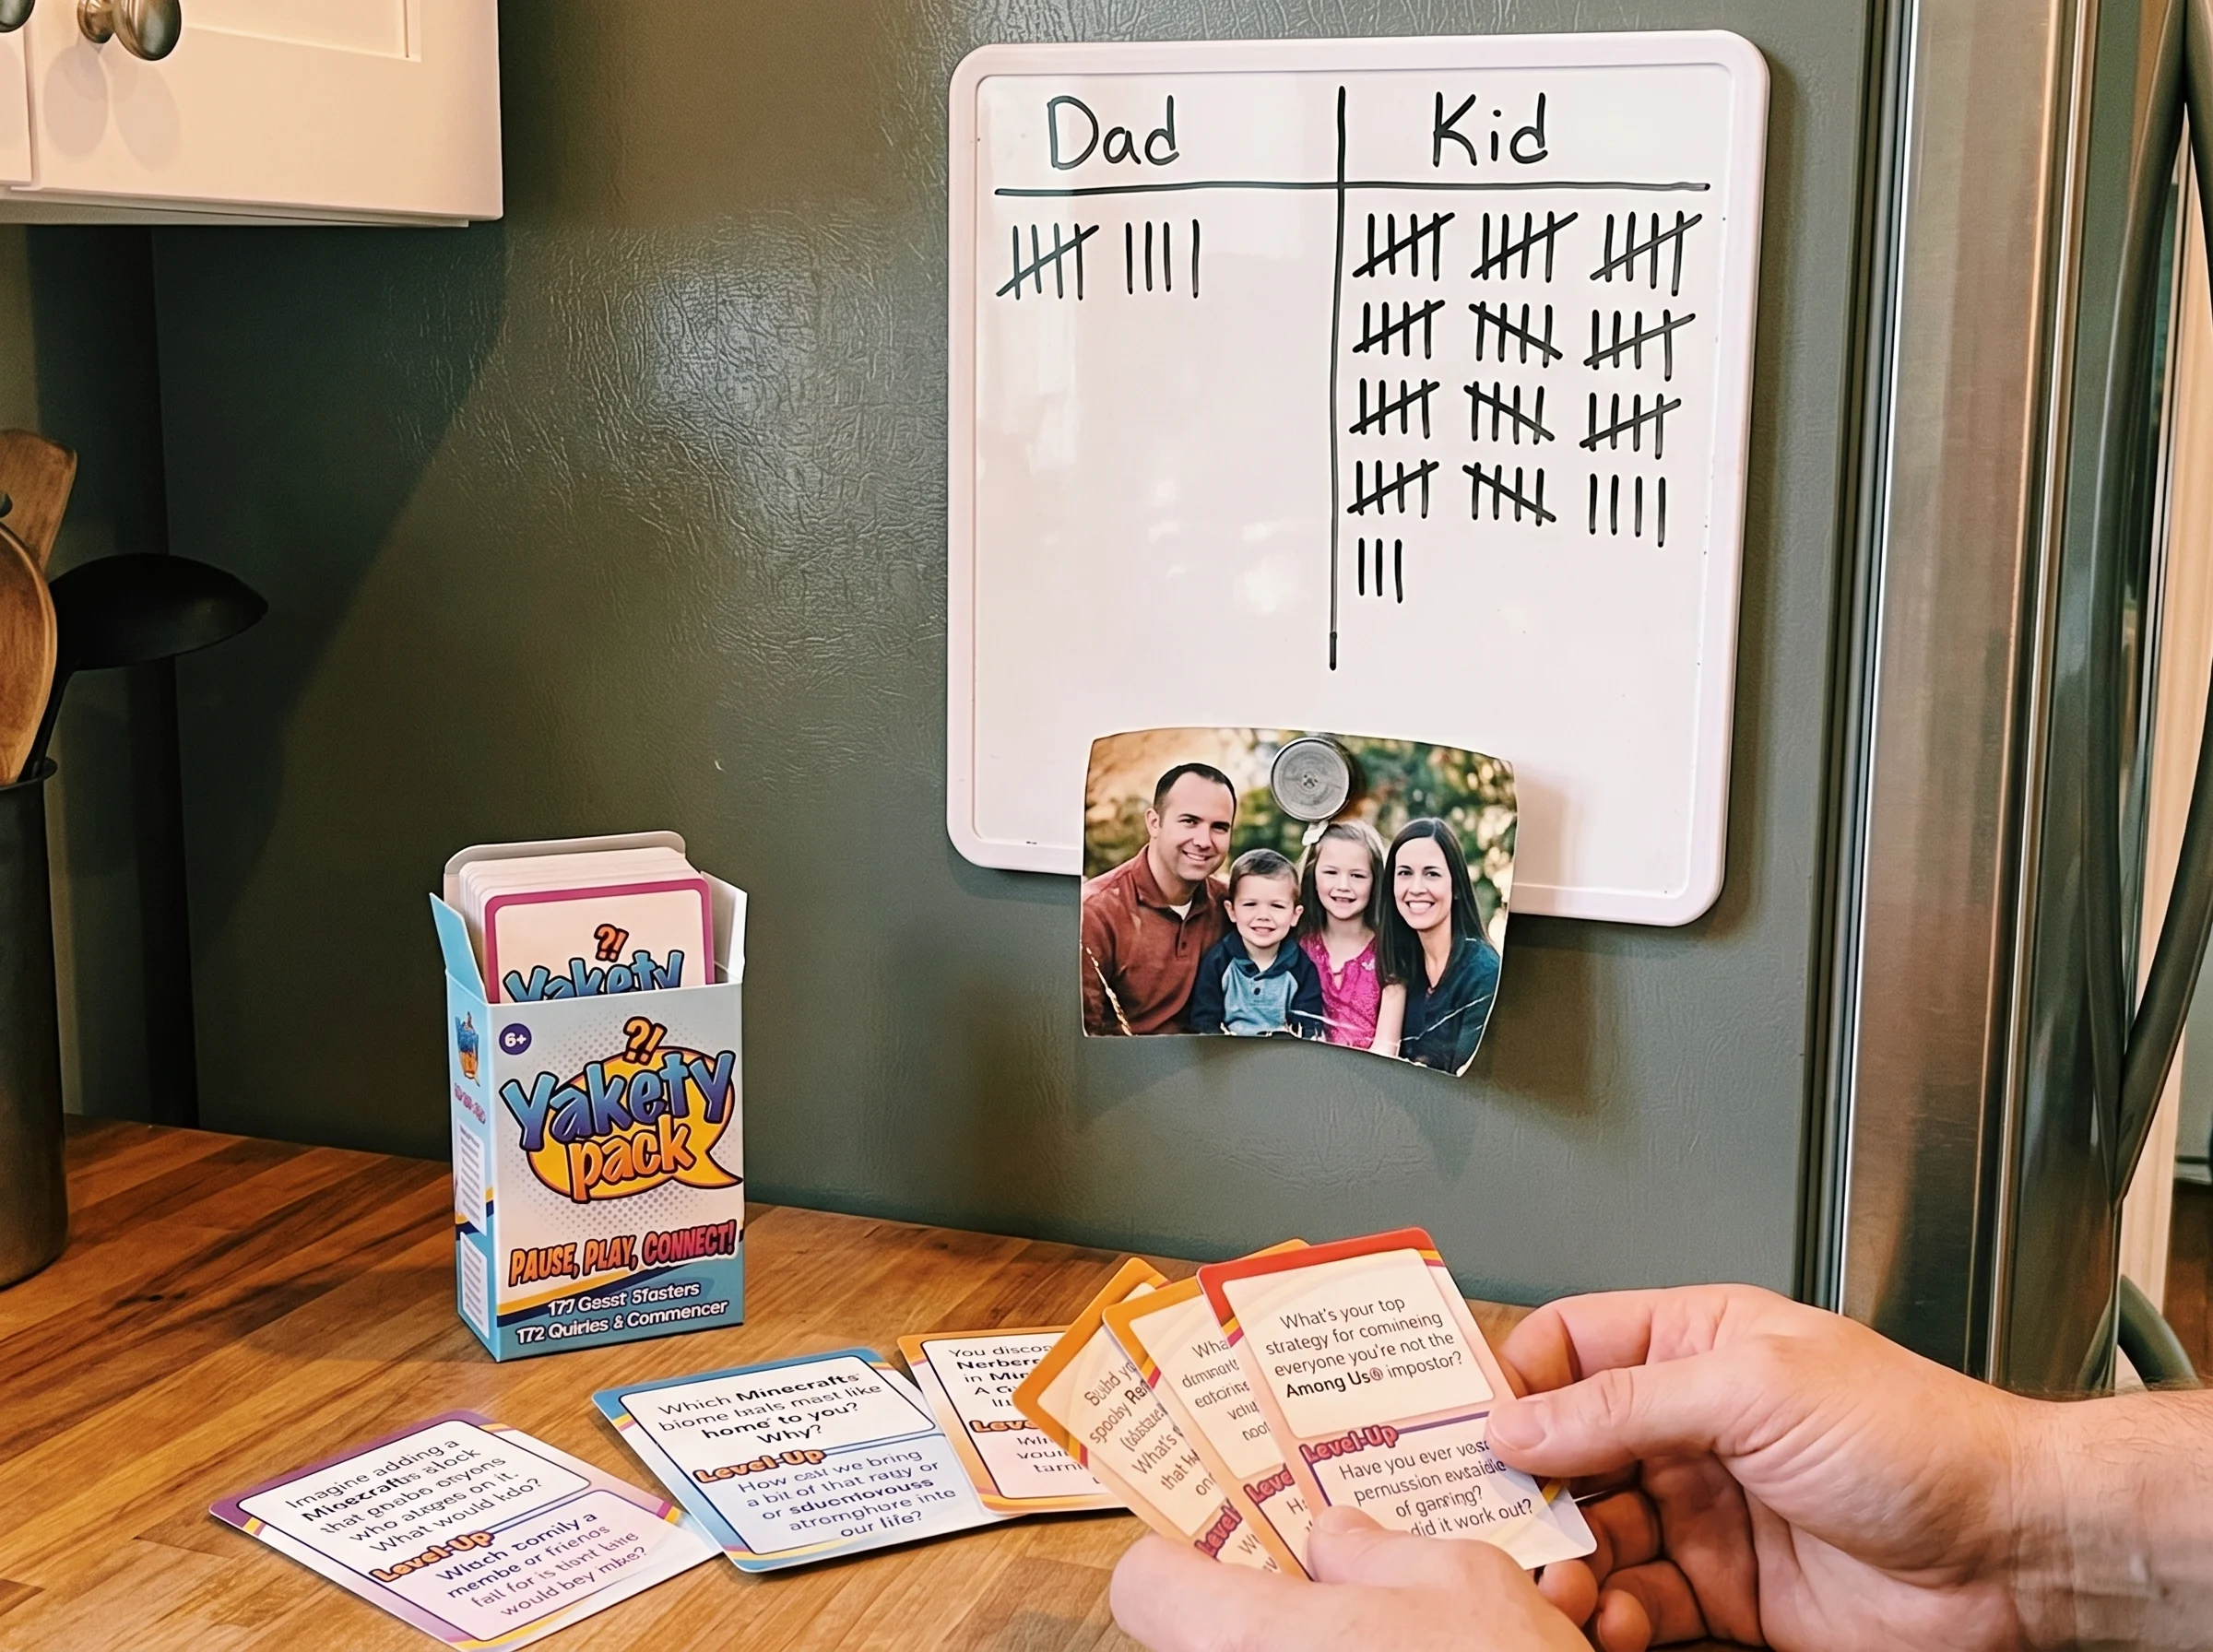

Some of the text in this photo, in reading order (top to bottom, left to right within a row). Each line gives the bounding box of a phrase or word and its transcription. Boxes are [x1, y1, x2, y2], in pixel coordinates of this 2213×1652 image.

[1047, 92, 1180, 169] Dad
[1432, 91, 1548, 166] Kid
[504, 1030, 527, 1047] 6+
[499, 1050, 736, 1151] Yakety
[566, 1115, 696, 1204] pack
[508, 1242, 579, 1287] PAUSE,
[583, 1235, 638, 1276] PLAY,
[642, 1219, 738, 1267] CONNECT!
[613, 1316, 624, 1329] &
[627, 1300, 728, 1327] Commencer
[1280, 1298, 1405, 1329] What's your top
[949, 1348, 986, 1358] You
[1266, 1334, 1328, 1355] strategy
[1332, 1328, 1355, 1342] for
[1274, 1333, 1455, 1376] everyone you're not the
[964, 1375, 982, 1383] in
[975, 1386, 990, 1395] A
[1286, 1377, 1346, 1398] Among
[1386, 1351, 1462, 1378] impostor?
[658, 1396, 731, 1415] Which
[658, 1413, 728, 1432] biome
[791, 1392, 843, 1407] mast
[845, 1386, 882, 1398] like
[778, 1415, 802, 1424] to
[808, 1402, 858, 1422] you?
[756, 1424, 822, 1444] Why?
[1298, 1424, 1399, 1465] Level-Up
[285, 1440, 460, 1508] Imagine adding a
[692, 1449, 827, 1484] Level-Up
[738, 1477, 787, 1493] How
[833, 1462, 863, 1473] we
[866, 1451, 923, 1467] bring
[1339, 1462, 1382, 1481] Have
[1384, 1455, 1415, 1475] you
[1419, 1446, 1453, 1464] ever
[747, 1498, 760, 1507] a
[822, 1477, 865, 1492] that
[920, 1462, 940, 1472] or
[349, 1520, 397, 1541] who
[469, 1481, 496, 1493] on
[370, 1526, 433, 1552] What
[432, 1498, 495, 1527] would
[583, 1514, 598, 1522] a
[762, 1511, 782, 1520] or
[841, 1510, 922, 1537] our life?
[1395, 1500, 1414, 1518] of
[1438, 1519, 1453, 1533] it
[1453, 1506, 1497, 1527] work
[1498, 1498, 1534, 1519] out?
[368, 1530, 495, 1583] Level-Up
[501, 1586, 560, 1616] would
[557, 1572, 596, 1590] bey
[507, 1577, 535, 1593] for
